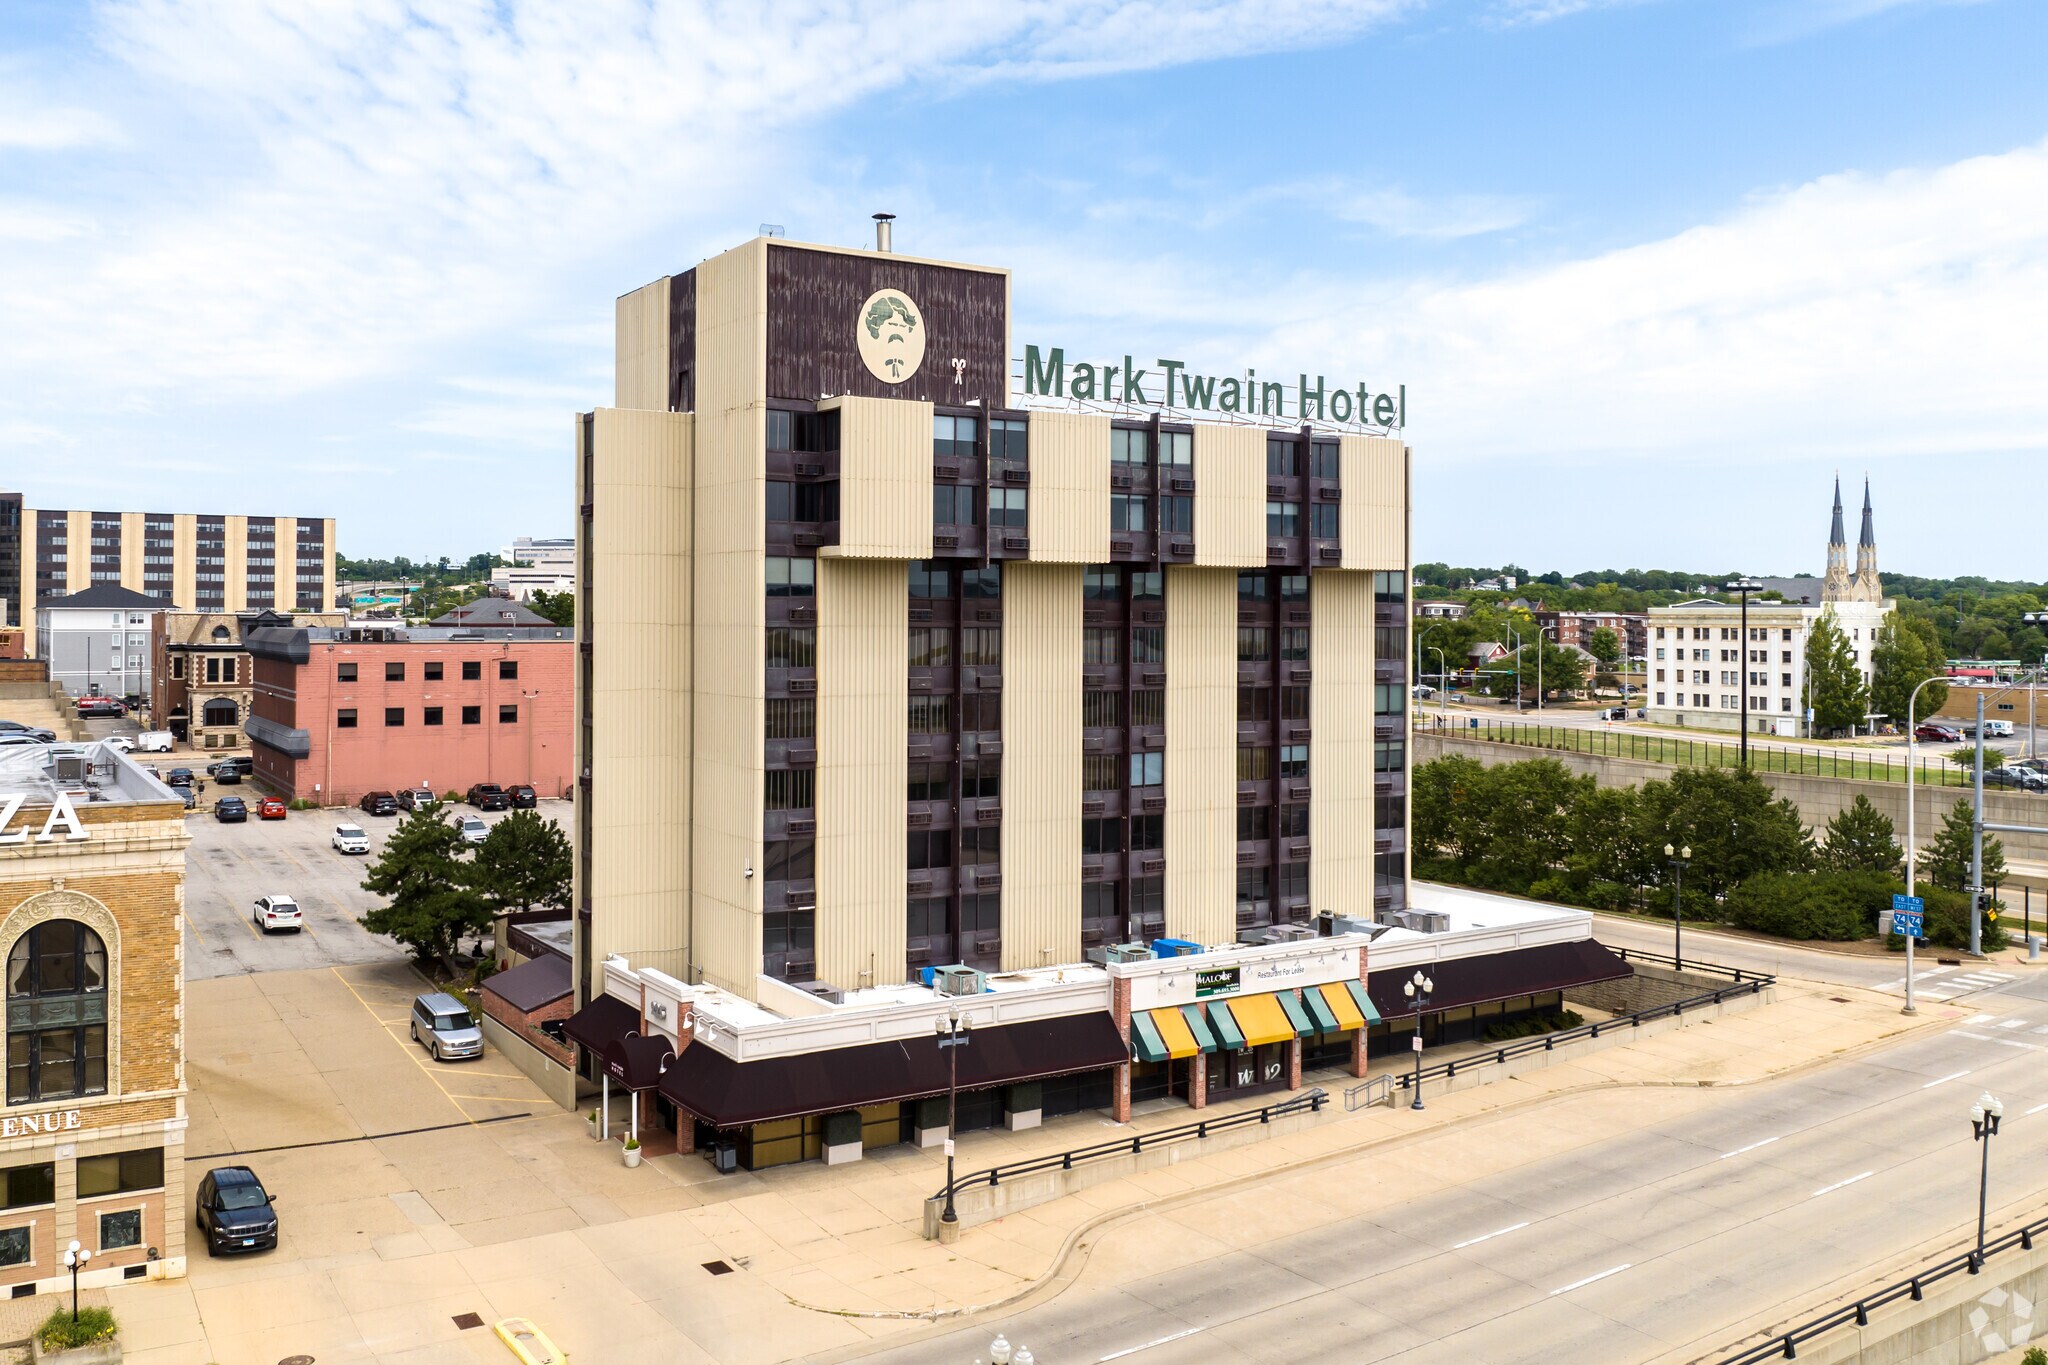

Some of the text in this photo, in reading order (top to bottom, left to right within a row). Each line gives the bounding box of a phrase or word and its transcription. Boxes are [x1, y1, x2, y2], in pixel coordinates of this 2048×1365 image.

[1025, 344, 1406, 427] Mark Twain Hotel
[1896, 914, 1906, 922] 74
[1910, 916, 1920, 924] 74
[1, 1109, 82, 1138] ENUE
